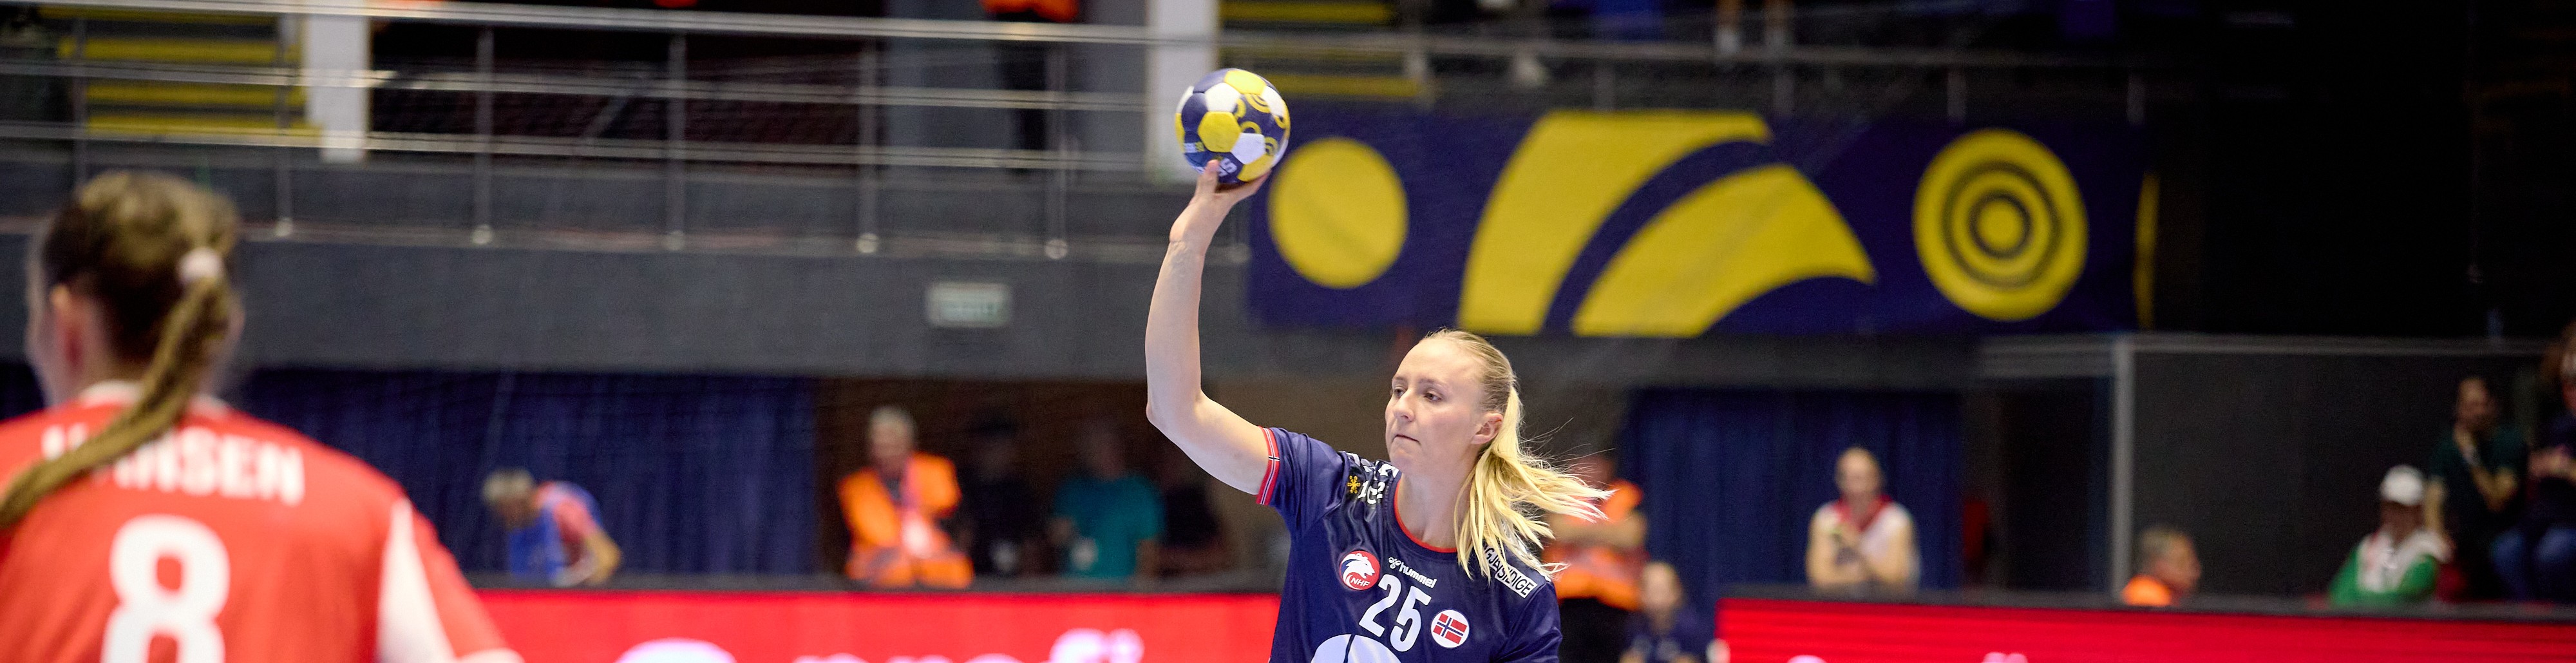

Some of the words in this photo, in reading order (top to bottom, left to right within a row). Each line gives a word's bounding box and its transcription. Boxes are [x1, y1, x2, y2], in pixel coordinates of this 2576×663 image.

[41, 423, 305, 506] HNSEN
[100, 514, 231, 663] 8
[1350, 577, 1371, 587] NHF
[1359, 574, 1432, 652] 25
[1399, 562, 1437, 588] hummel
